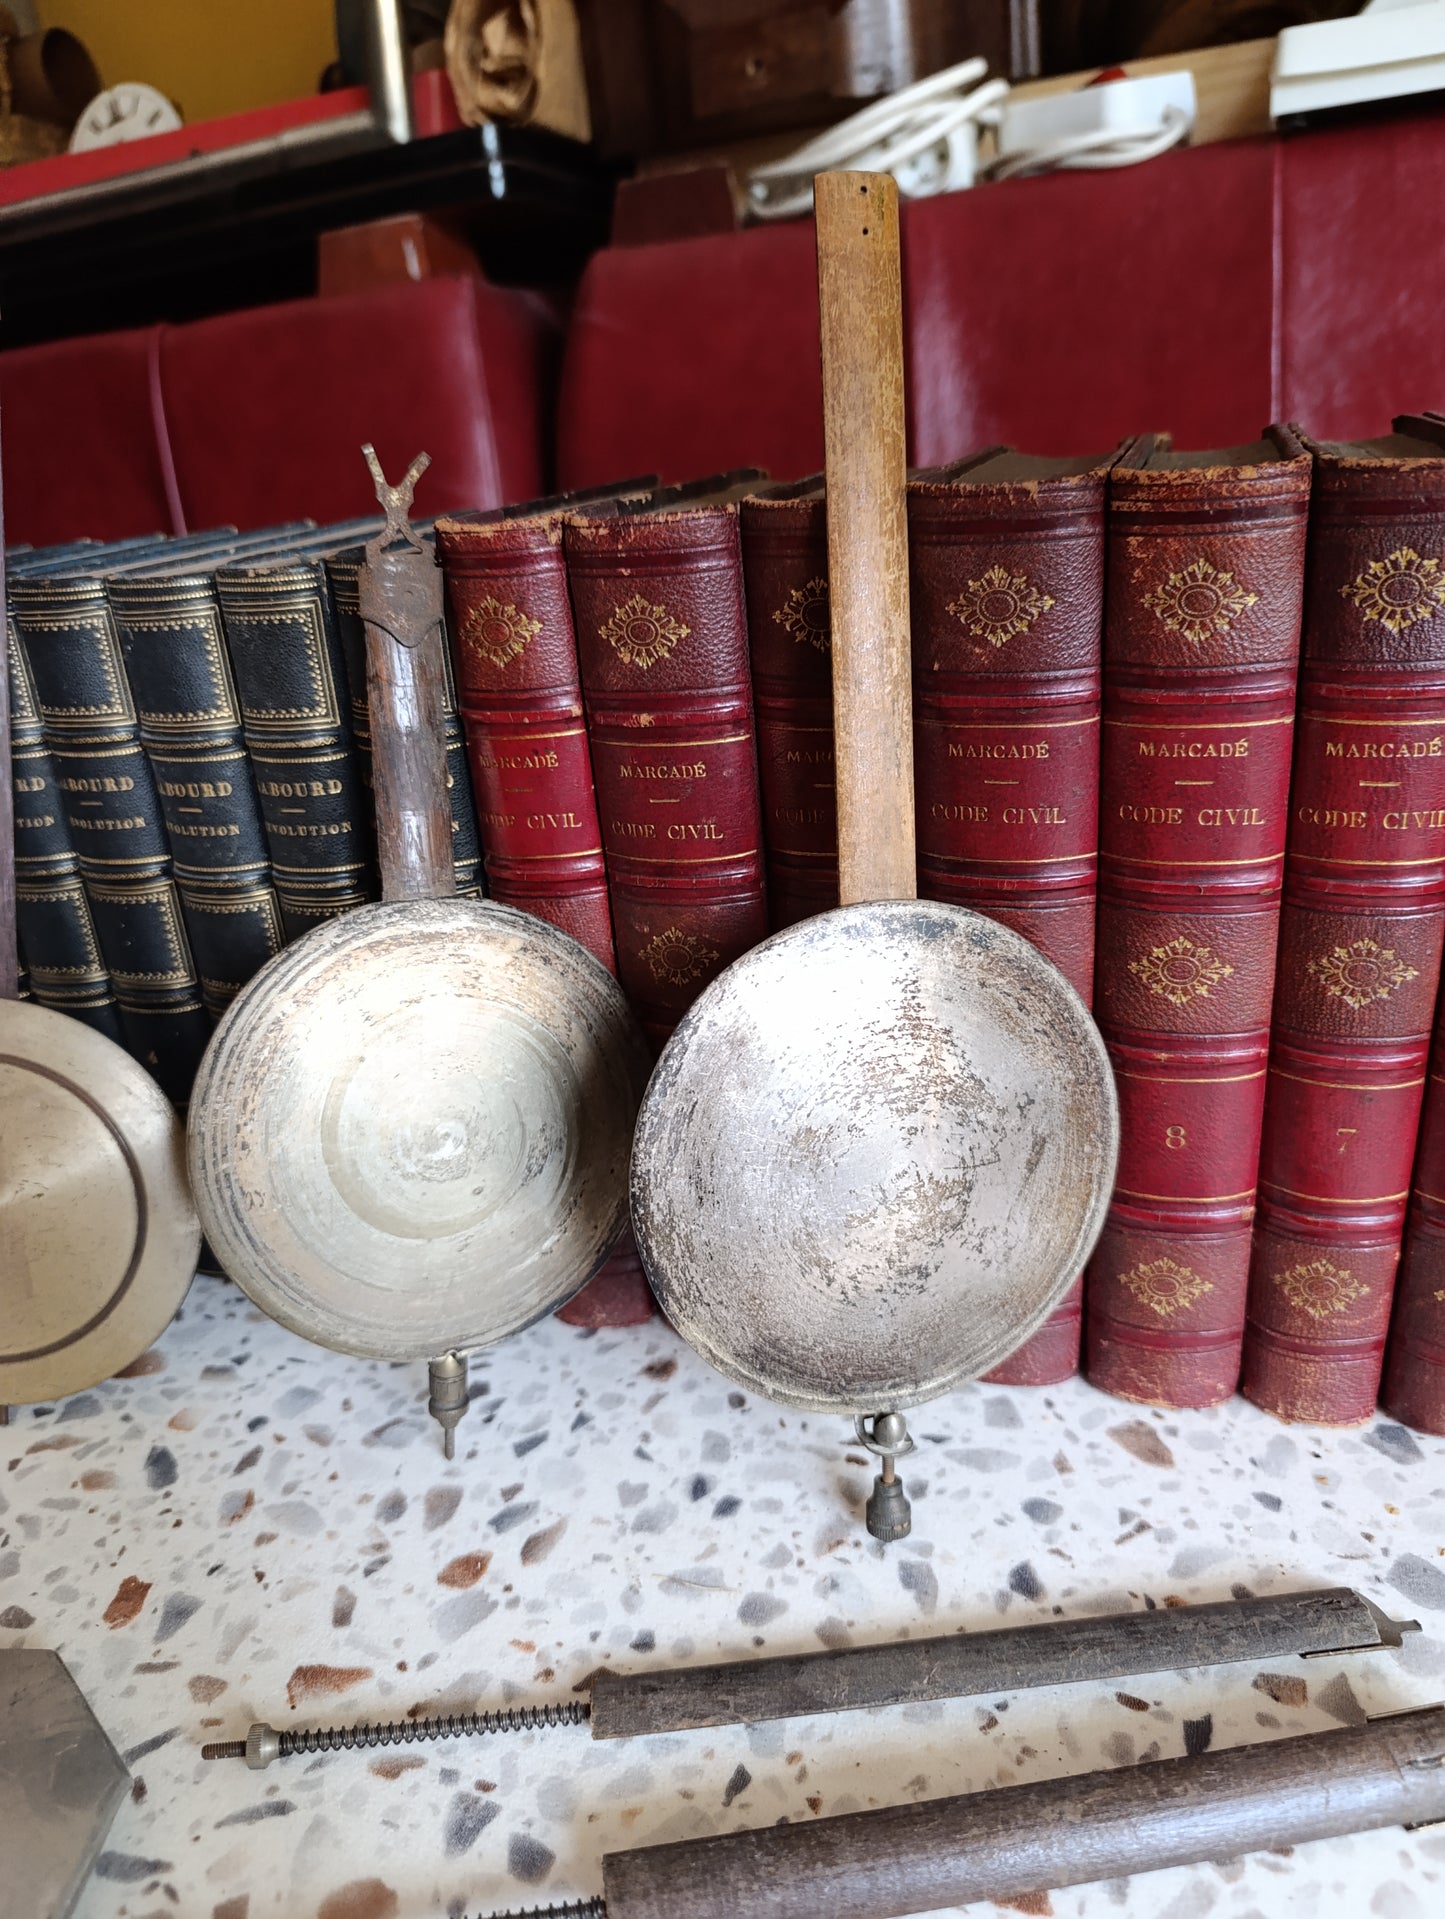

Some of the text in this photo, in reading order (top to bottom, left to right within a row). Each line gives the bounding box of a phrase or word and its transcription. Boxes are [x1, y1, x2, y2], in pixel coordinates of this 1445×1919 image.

[949, 741, 1050, 759] MARCADÉ
[1139, 738, 1249, 758] MARCADÉ
[1326, 737, 1443, 758] MARCADÉ
[480, 752, 559, 768] MARCADÉ
[620, 761, 707, 779] MARCADÉ
[59, 776, 135, 793] ABOURD
[157, 780, 233, 798] ABOURD
[257, 778, 343, 798] ABOURD
[527, 812, 583, 829] CIVIL
[932, 803, 1066, 824] CODE CIVIL
[1119, 804, 1266, 826] CODE CIVIL
[1299, 807, 1445, 830] CODE CIVIL
[612, 821, 724, 840] CODE CIVIL
[1165, 1125, 1186, 1149] 8
